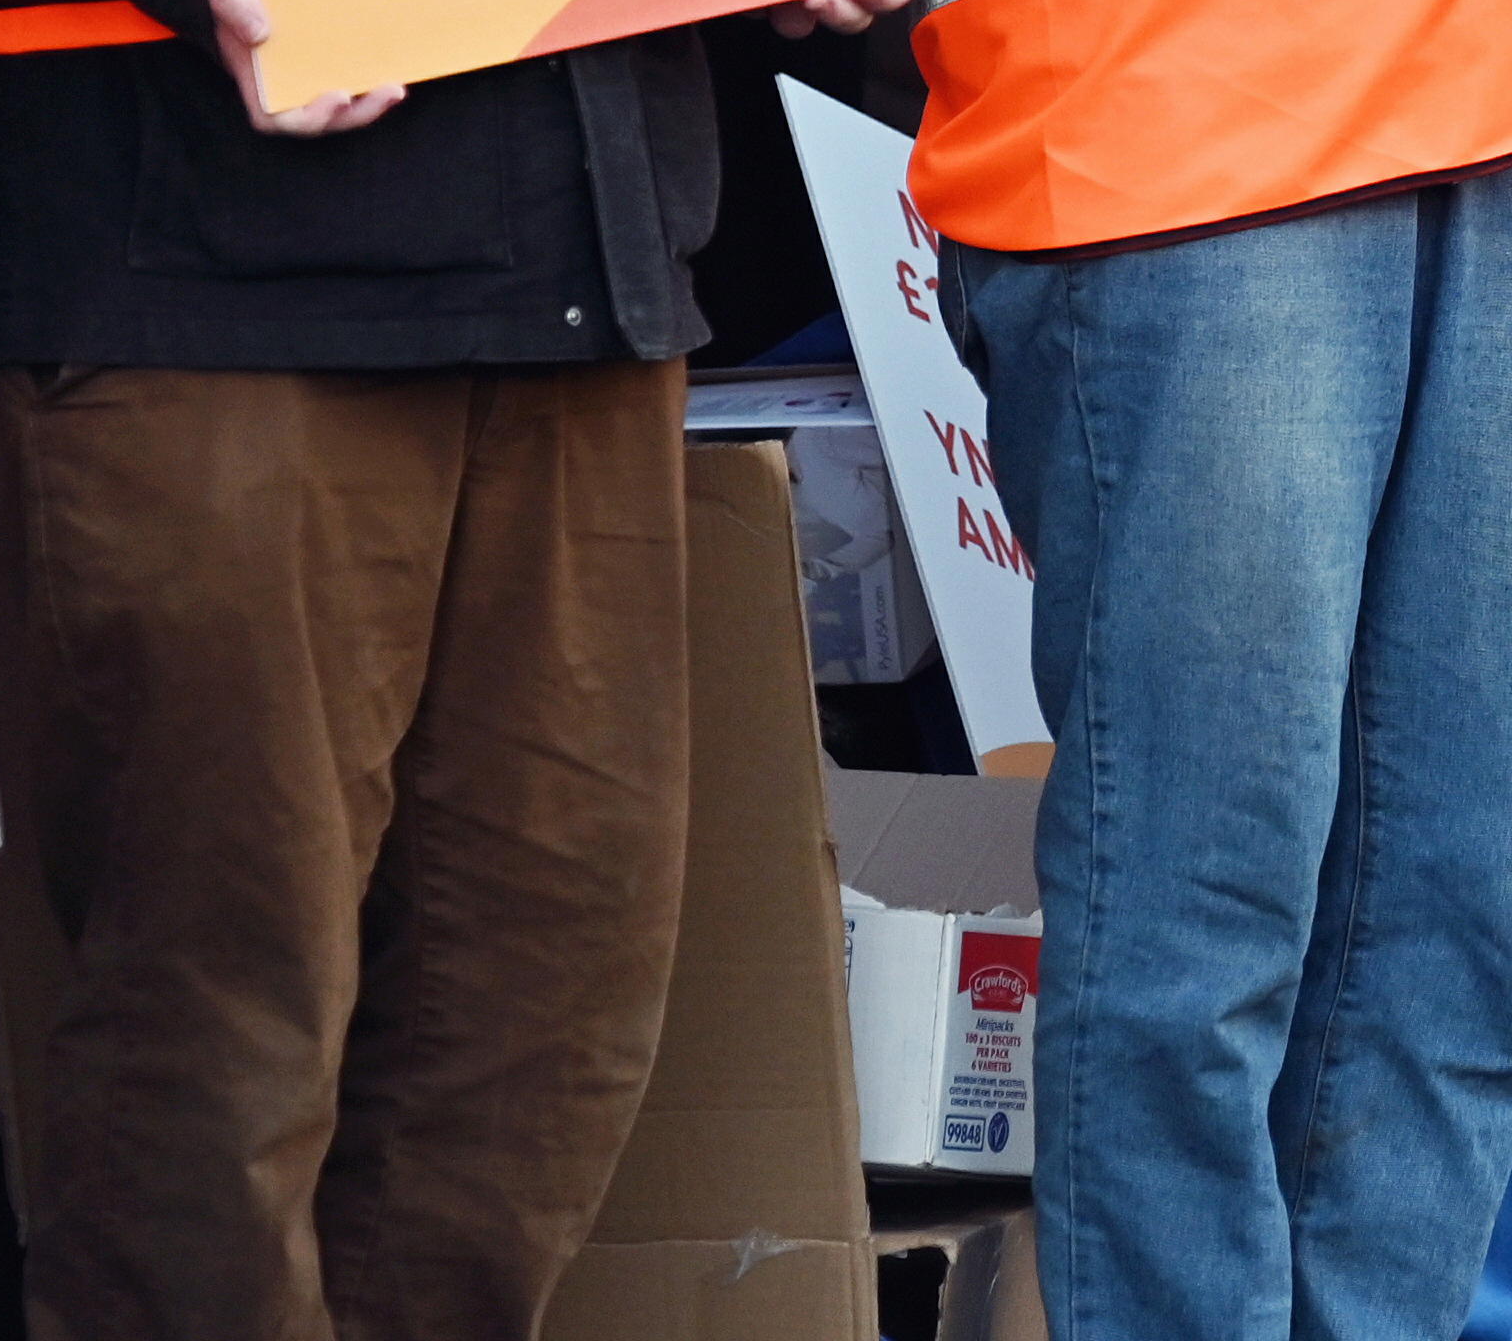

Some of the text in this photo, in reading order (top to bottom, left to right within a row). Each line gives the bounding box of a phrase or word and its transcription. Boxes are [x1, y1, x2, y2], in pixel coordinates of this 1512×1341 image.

[973, 969, 1023, 996] Crawford's
[975, 1017, 1015, 1033] Minipacks
[991, 1035, 1021, 1048] BISCUITS
[990, 1048, 1009, 1059] PACK
[977, 1060, 1012, 1073] VARIETIES
[947, 1123, 982, 1145] 99848
